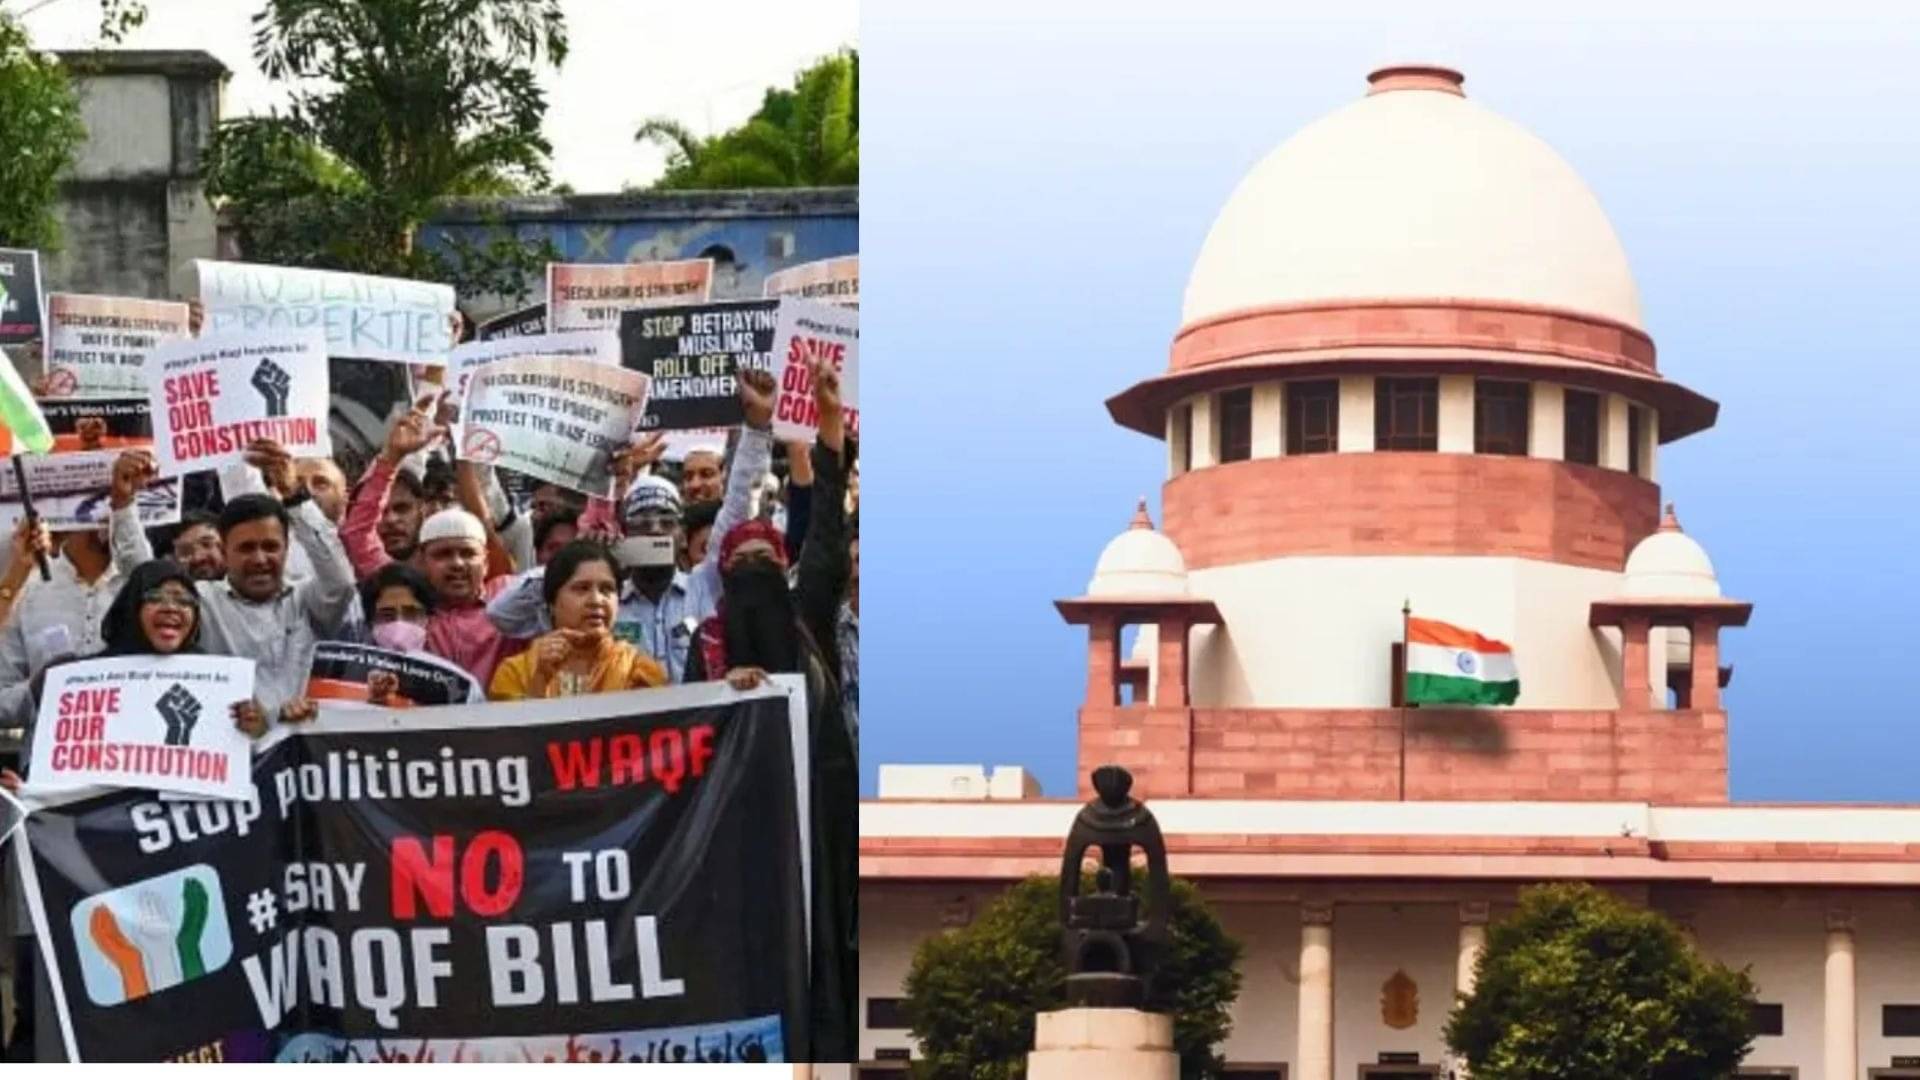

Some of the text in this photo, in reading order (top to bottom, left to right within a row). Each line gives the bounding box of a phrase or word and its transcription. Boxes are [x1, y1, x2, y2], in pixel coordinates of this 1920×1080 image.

[641, 315, 684, 337] STOP
[678, 331, 754, 355] MUSLIMS
[653, 356, 691, 377] ROLL
[699, 354, 729, 375] OFF
[164, 370, 220, 404] SAVE
[169, 401, 212, 432] OUR
[472, 409, 527, 427] PROTECT
[531, 415, 552, 433] THE
[173, 417, 317, 461] CONSTITUTION
[59, 688, 121, 716] SAVE
[55, 715, 104, 743] OUR
[51, 743, 229, 783] CONSTITUTION
[131, 725, 715, 854] Stop politicing WAQF
[389, 830, 525, 920] NO
[563, 848, 631, 902] TO
[242, 915, 686, 1031] WAQF BILL
